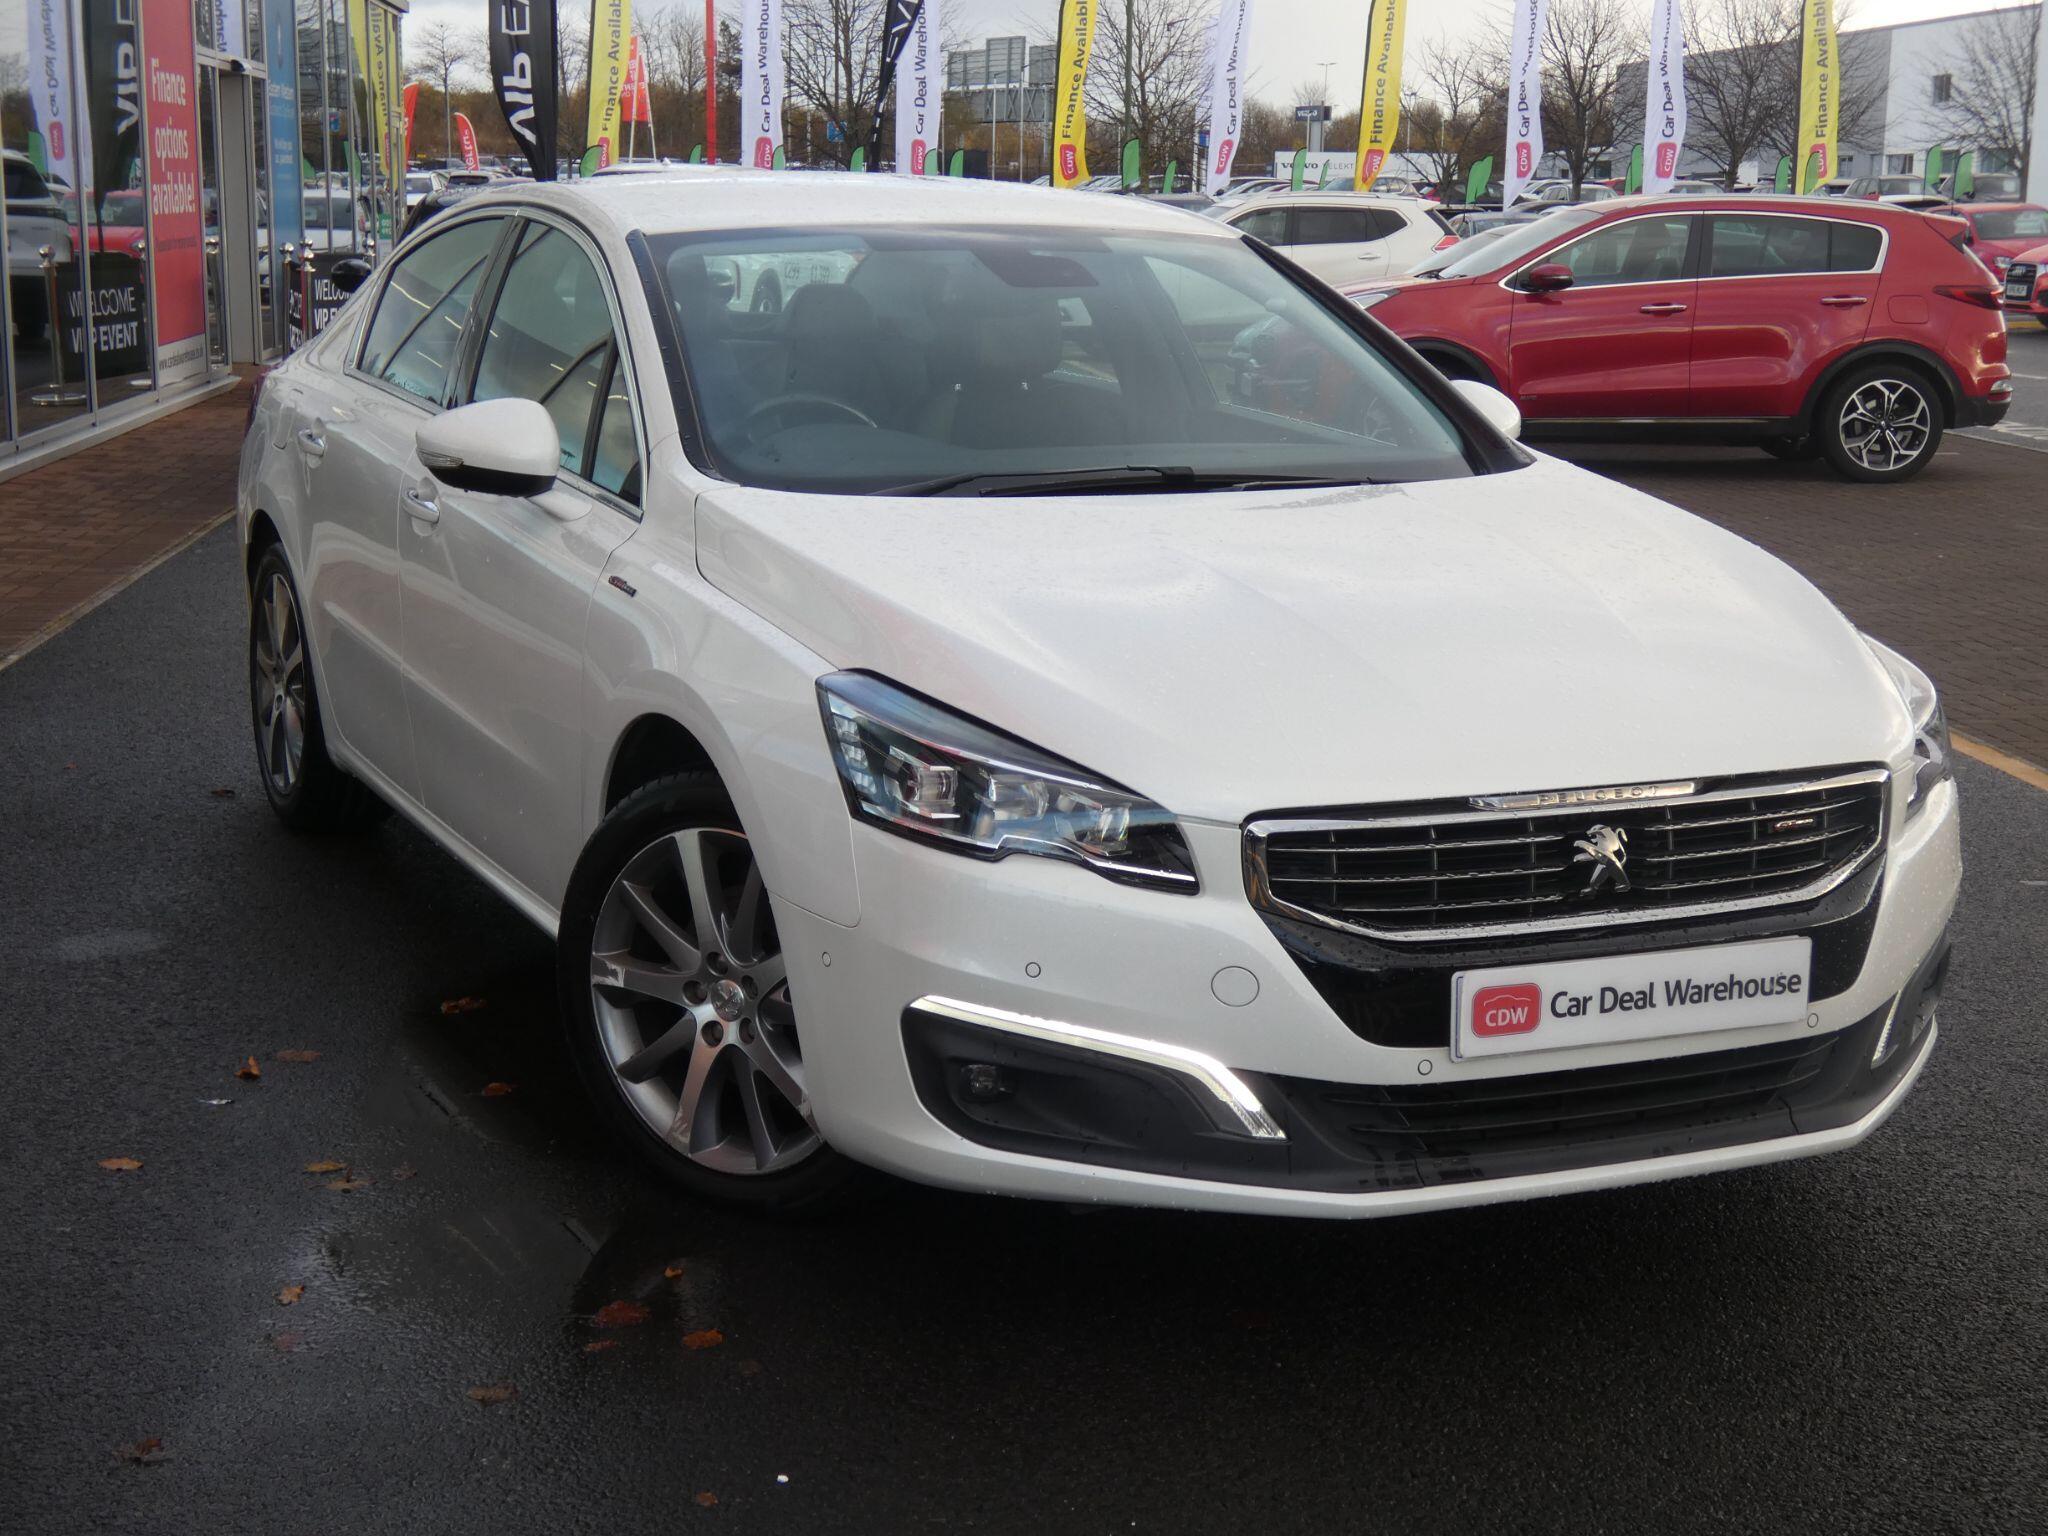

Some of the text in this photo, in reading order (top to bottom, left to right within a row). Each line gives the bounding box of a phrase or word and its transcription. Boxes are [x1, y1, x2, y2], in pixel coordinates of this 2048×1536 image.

[117, 42, 139, 136] VIP
[152, 58, 187, 107] Finance
[602, 65, 619, 131] Finance
[760, 73, 770, 106] Deal
[914, 76, 927, 108] Deal
[1227, 77, 1236, 109] Deal
[1518, 80, 1529, 112] Deal
[1663, 81, 1674, 112] Deal
[761, 109, 771, 132] Car
[1062, 73, 1081, 138] Finance
[1370, 78, 1386, 144] Finance
[1816, 73, 1829, 138] Finance
[916, 112, 925, 134] Car
[1227, 113, 1236, 135] Car
[1519, 115, 1531, 137] Car
[1662, 115, 1675, 138] Car
[155, 116, 189, 171] options
[764, 144, 772, 167] CDW
[1218, 145, 1229, 168] CDW
[1520, 148, 1528, 171] CDW
[1664, 148, 1675, 172] CDW
[152, 172, 196, 216] available!
[314, 308, 329, 331] VIP
[100, 321, 139, 352] EVENT
[1537, 785, 1660, 804] PEUGEOT
[1550, 972, 1802, 1019] Car Deal Warehouse
[1485, 1007, 1529, 1027] CDW
